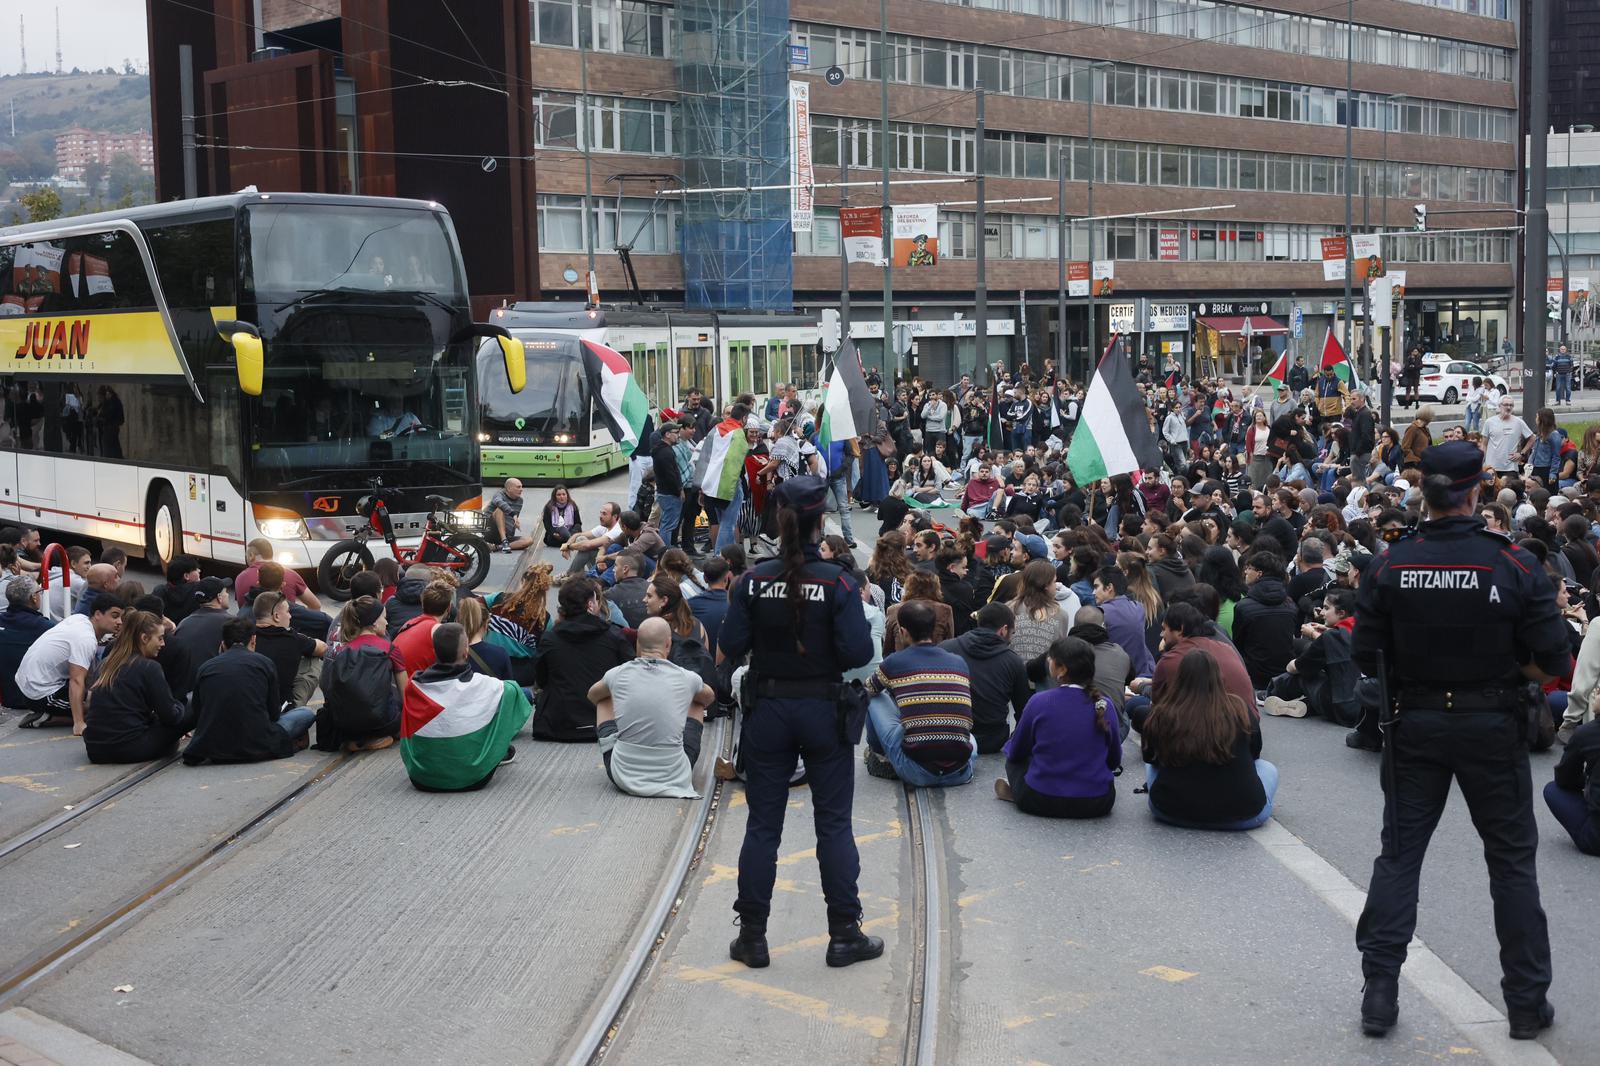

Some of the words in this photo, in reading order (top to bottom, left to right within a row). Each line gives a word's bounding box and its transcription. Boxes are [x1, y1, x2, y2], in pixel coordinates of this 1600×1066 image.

[829, 72, 840, 80] 20
[1160, 305, 1187, 316] MEDICOS
[1212, 303, 1233, 313] BREAK
[15, 319, 91, 360] JUAN
[1400, 570, 1479, 589] ERTZAINTZA
[1489, 585, 1501, 603] A
